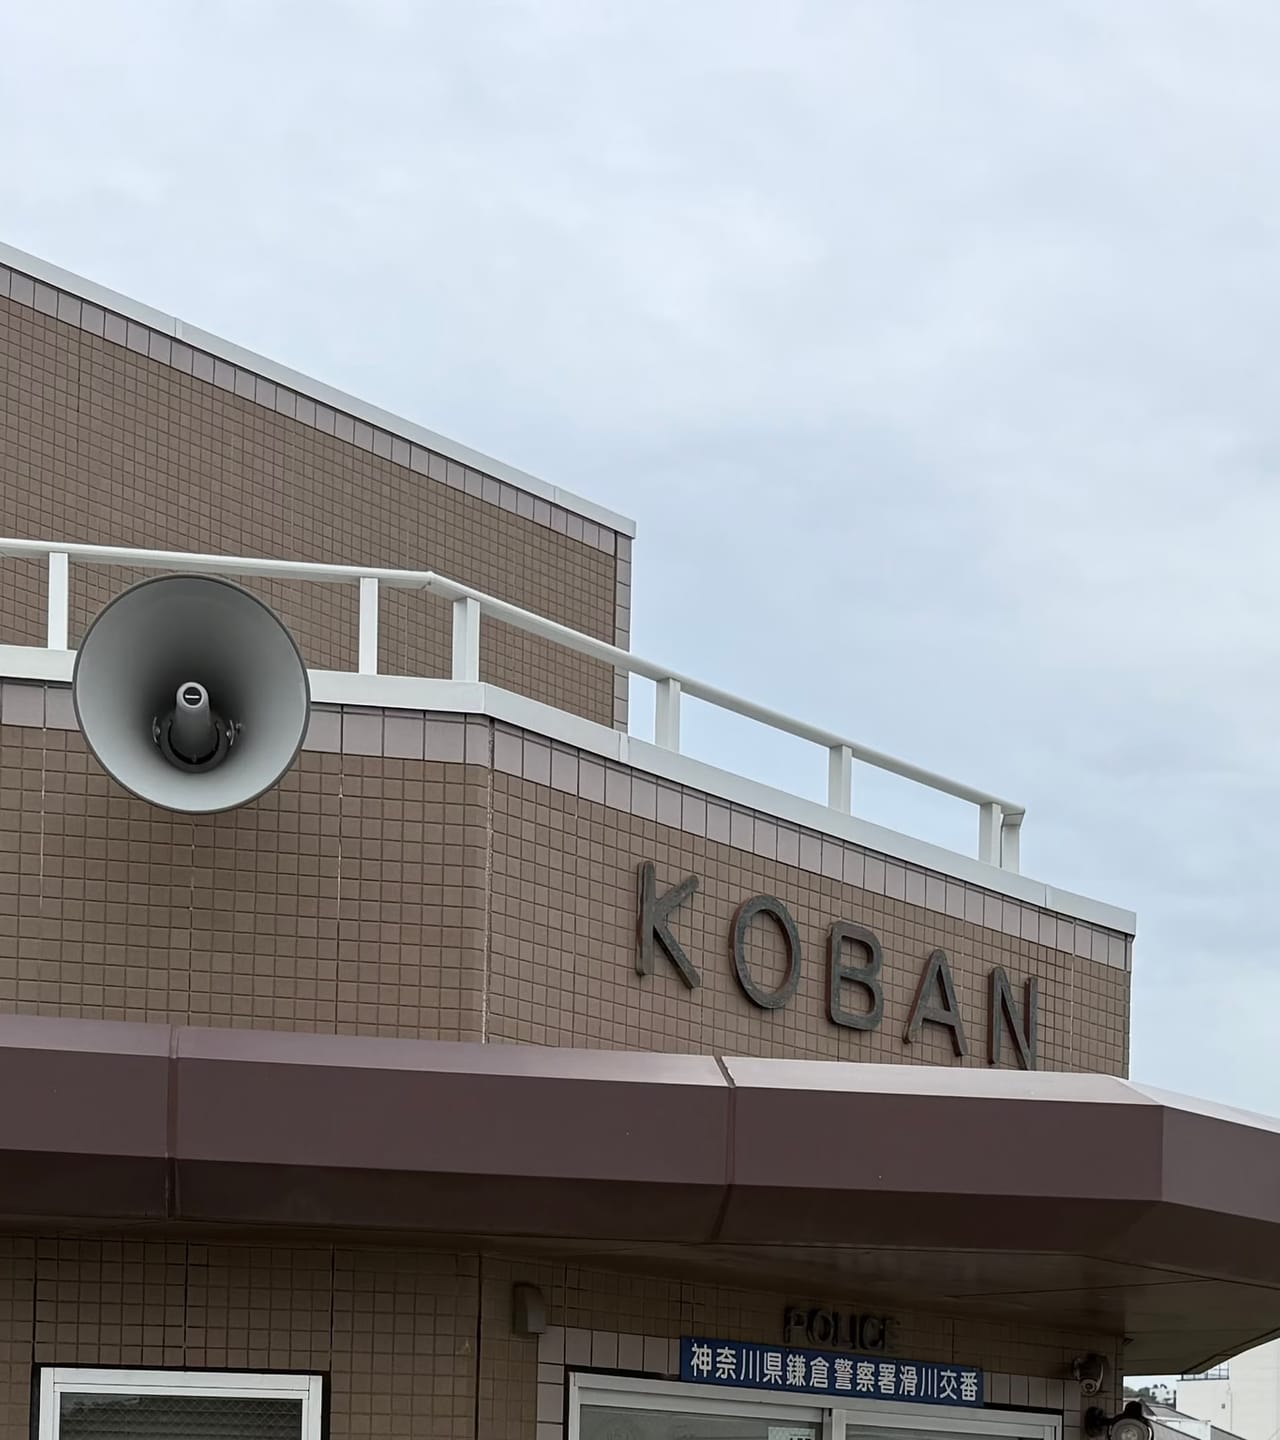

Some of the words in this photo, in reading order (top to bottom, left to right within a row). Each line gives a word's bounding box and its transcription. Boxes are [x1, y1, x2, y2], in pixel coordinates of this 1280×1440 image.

[636, 860, 1039, 1070] KOBAN
[783, 1304, 902, 1354] POLICE
[690, 1342, 979, 1401] 神奈川県鎌倉警察署滑川交番
